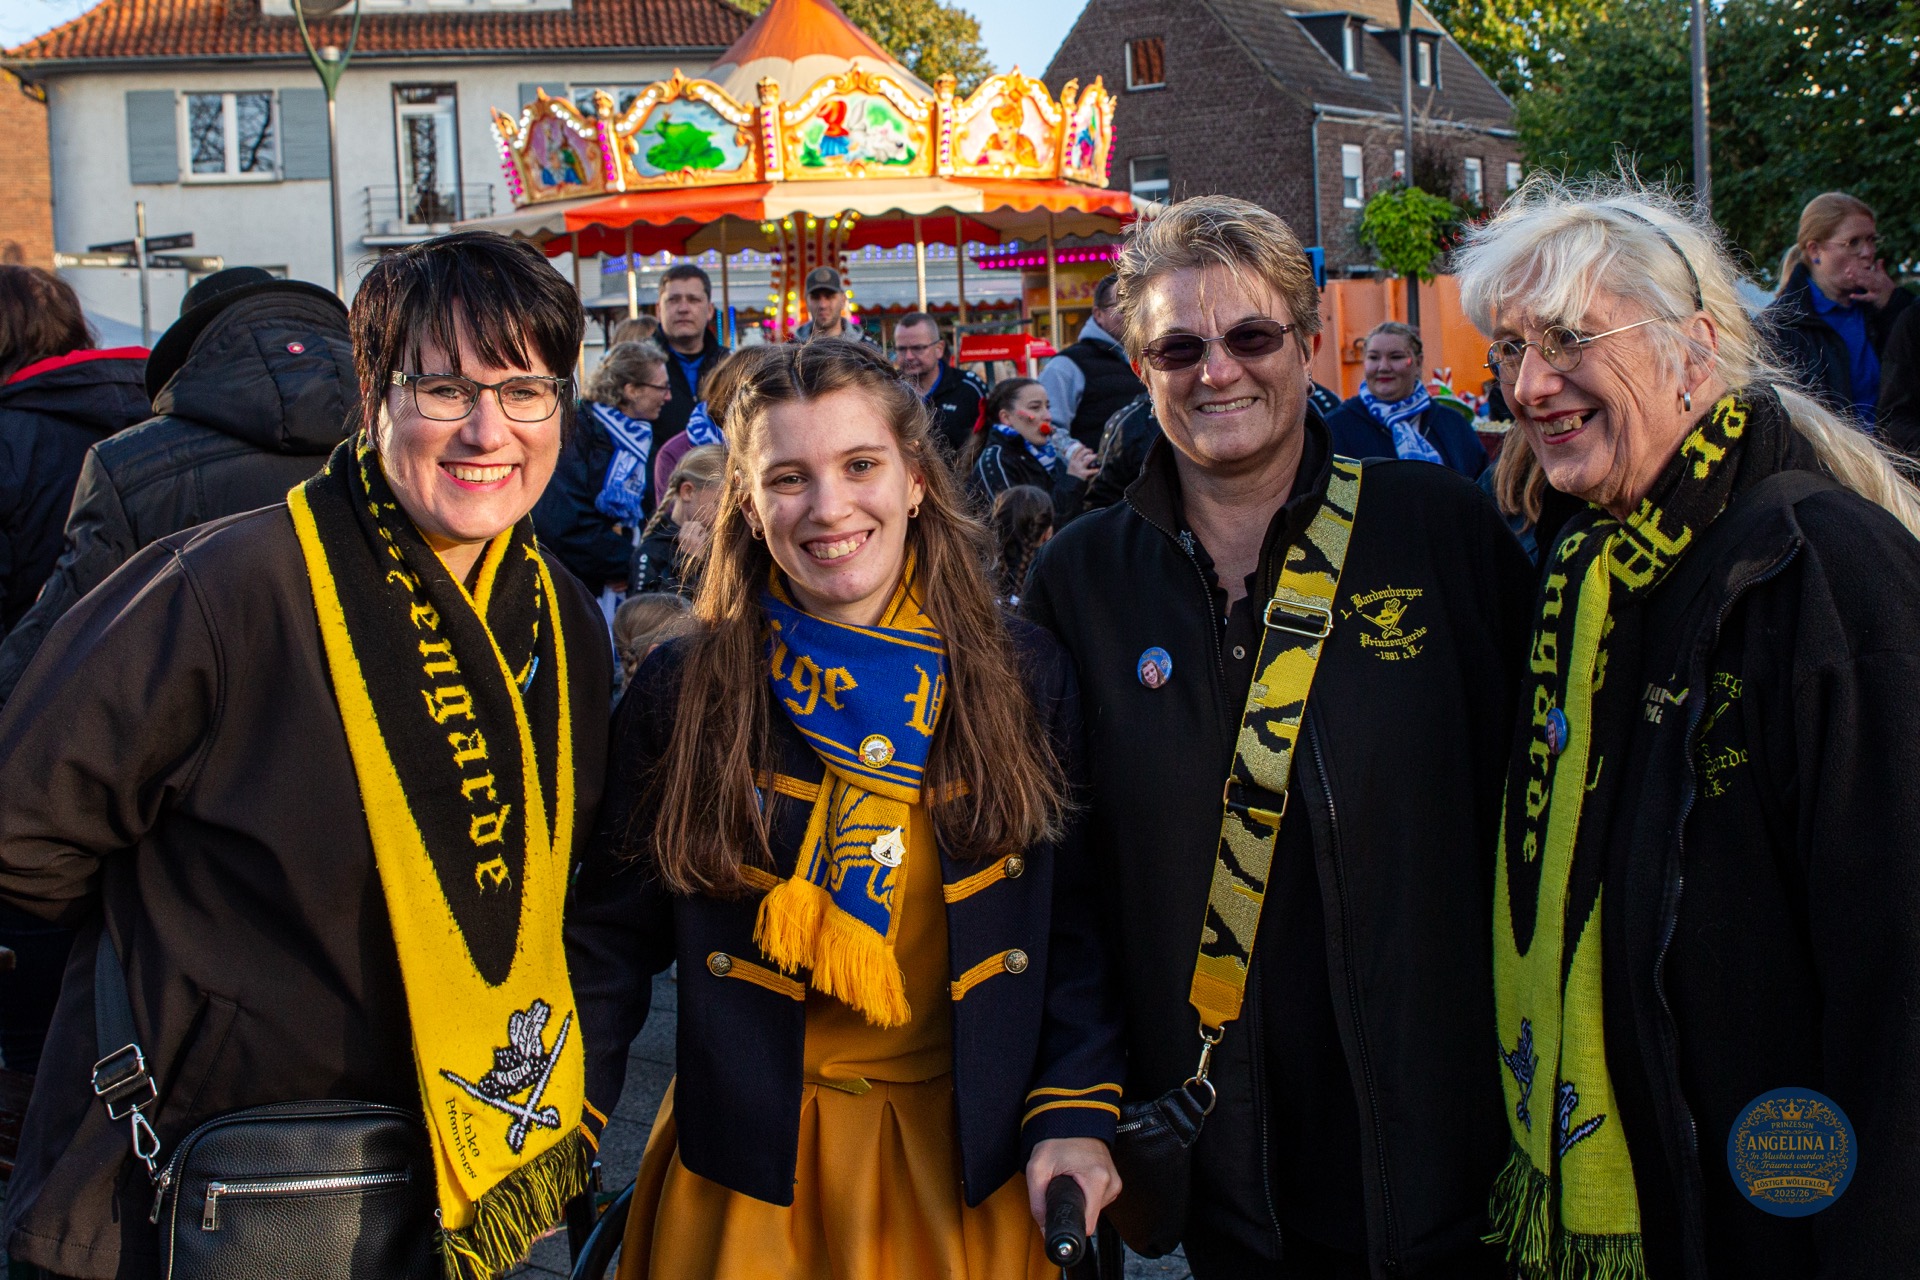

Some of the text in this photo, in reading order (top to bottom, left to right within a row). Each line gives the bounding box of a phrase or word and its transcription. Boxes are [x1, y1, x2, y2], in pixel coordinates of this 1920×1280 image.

[1350, 584, 1423, 613] Bardenberger
[1359, 626, 1428, 648] Prinzengarde
[461, 1110, 480, 1158] Anke
